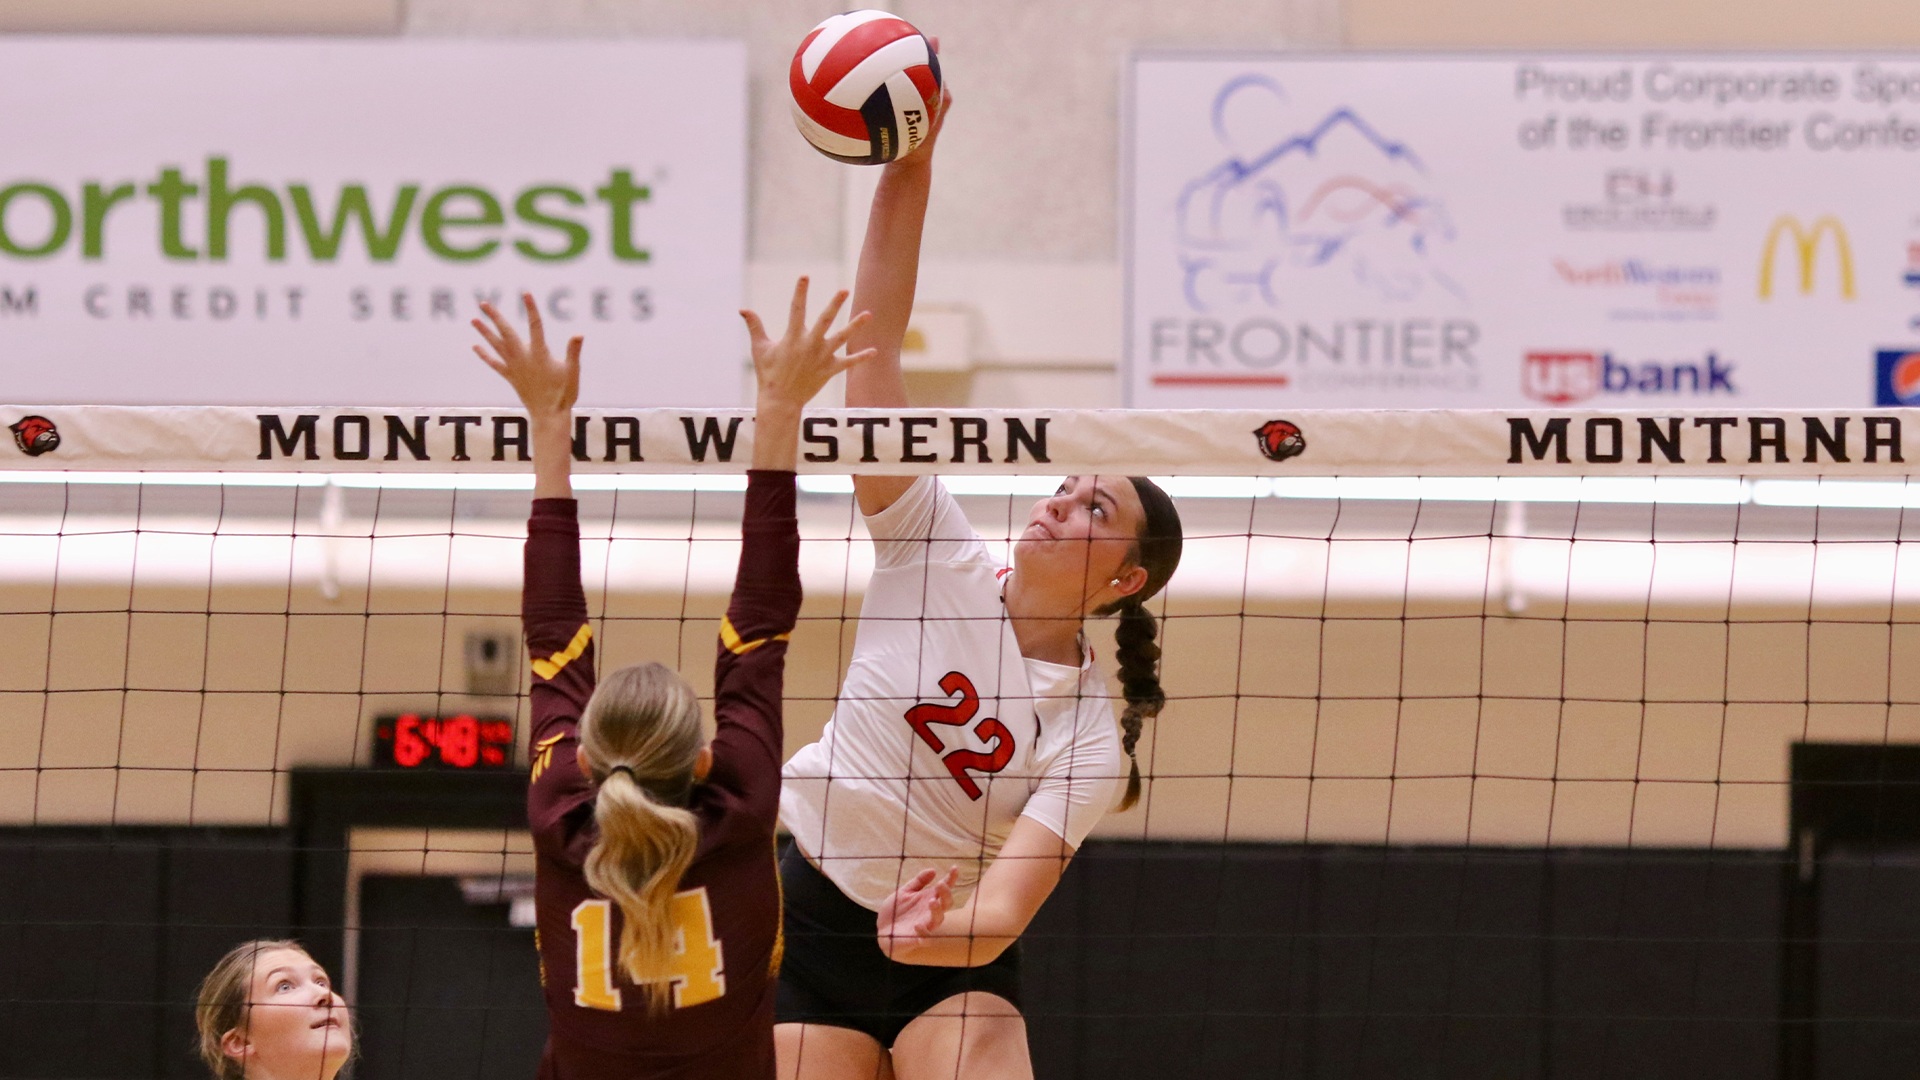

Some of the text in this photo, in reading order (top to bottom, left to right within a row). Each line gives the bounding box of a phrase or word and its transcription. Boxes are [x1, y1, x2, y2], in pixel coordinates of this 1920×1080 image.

[1516, 65, 1632, 101] Proud
[1644, 65, 1841, 107] Corporate
[902, 109, 922, 153] Bade
[1517, 114, 1558, 150] of
[1568, 114, 1629, 150] the
[1641, 113, 1791, 150] Frontier
[0, 155, 652, 262] orthwest
[84, 285, 308, 319] CREDIT
[1151, 318, 1481, 367] FRONTIER
[680, 416, 1051, 464] WSTERN
[1506, 416, 1905, 464] MONTANA
[904, 671, 1016, 801] 22
[571, 886, 727, 1012] 14
